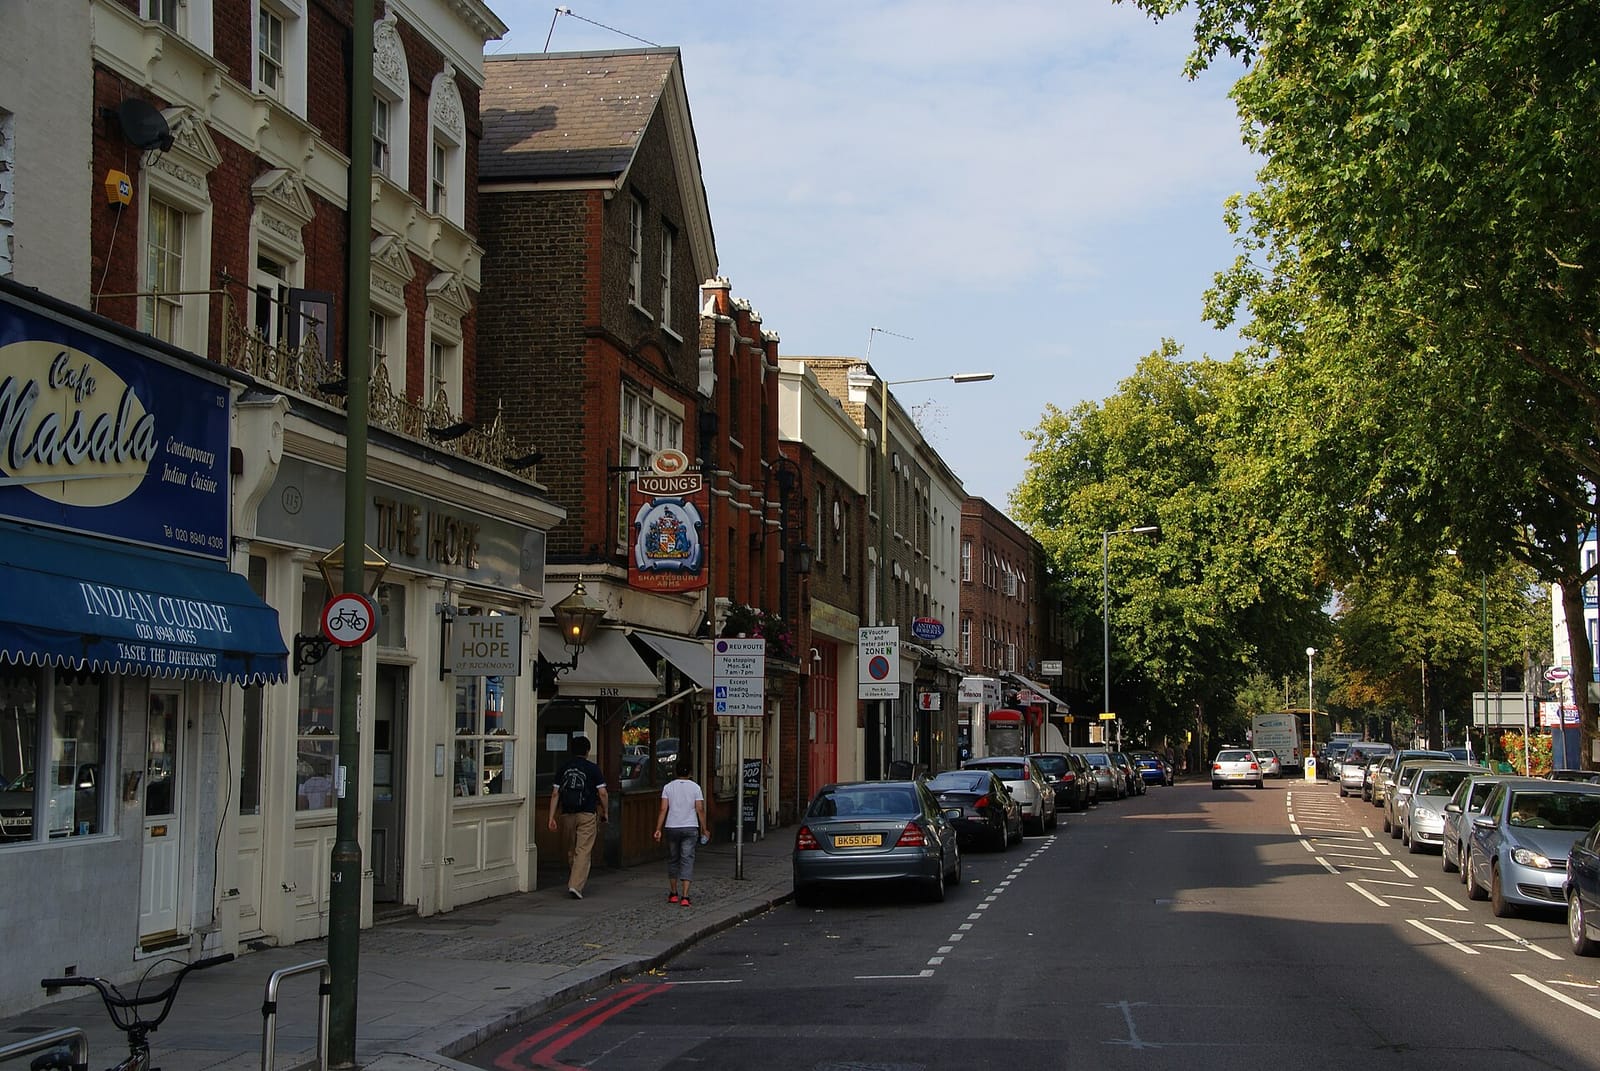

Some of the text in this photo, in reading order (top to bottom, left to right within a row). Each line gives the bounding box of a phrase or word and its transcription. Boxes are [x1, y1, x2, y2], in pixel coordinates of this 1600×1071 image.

[216, 395, 225, 408] 113
[0, 375, 159, 470] Masala
[166, 435, 216, 470] Contemporary
[161, 463, 218, 494] Indian Cuisine
[642, 477, 697, 491] YOUNG'S
[285, 493, 299, 509] 115
[175, 528, 188, 543] 020
[374, 496, 480, 570] THE HOPE
[657, 580, 681, 588] ARMS
[79, 582, 233, 634] INDIAN CUISINE
[135, 623, 197, 645] 020 8948 0055
[468, 622, 505, 638] THE
[462, 641, 510, 658] HOPE
[865, 647, 892, 655] ZONE N
[877, 640, 897, 648] parking
[117, 642, 217, 668] TASTE THE DIFFERENCE
[469, 661, 515, 670] RICHMOND
[600, 687, 619, 696] BAR
[838, 836, 860, 845] BK55
